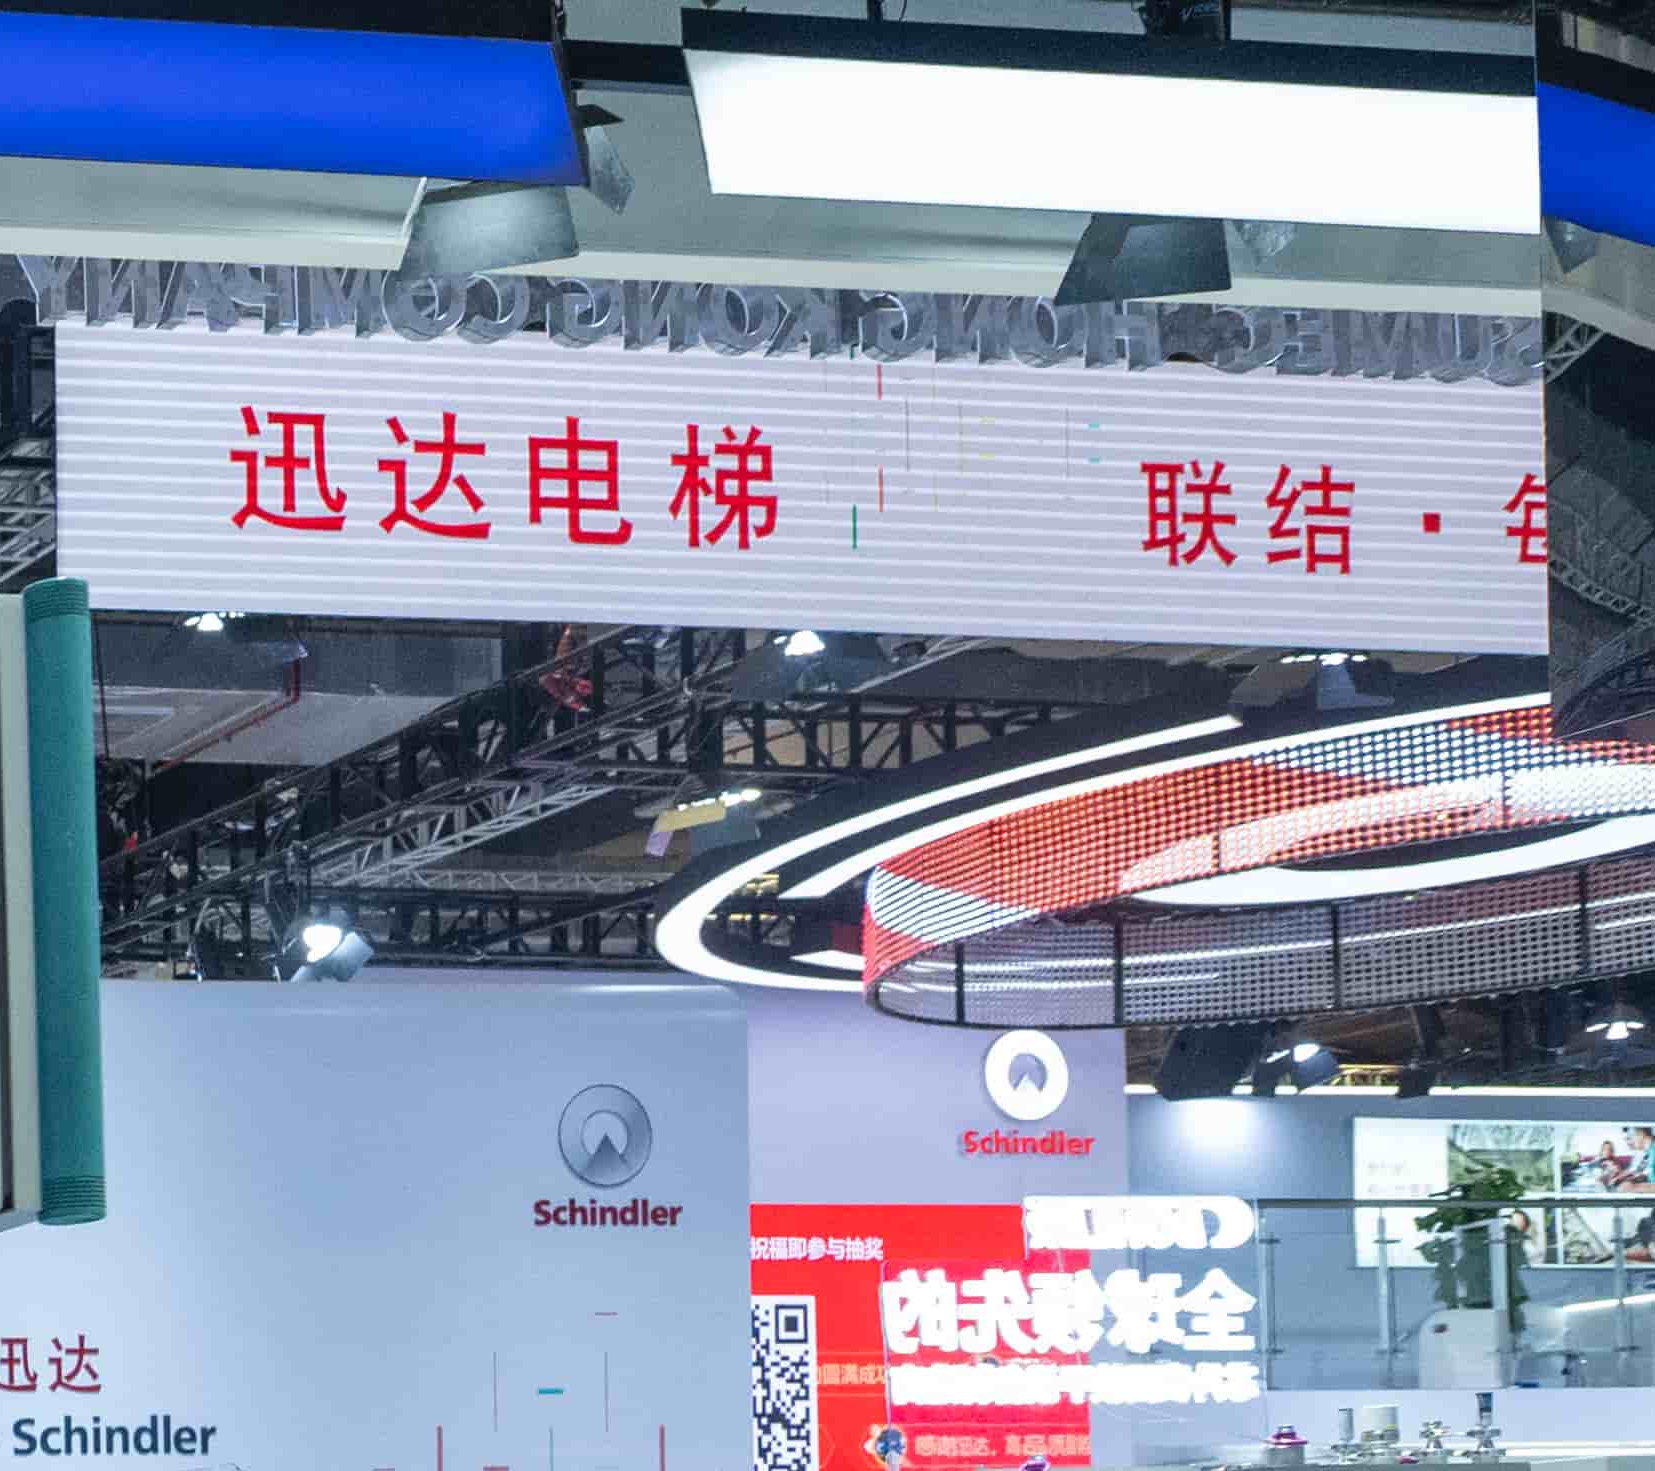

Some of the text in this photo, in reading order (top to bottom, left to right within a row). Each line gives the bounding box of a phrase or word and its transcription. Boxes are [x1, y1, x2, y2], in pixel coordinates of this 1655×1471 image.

[225, 404, 781, 554] 迅达电梯
[963, 1129, 1096, 1157] Schindler
[532, 1198, 682, 1228] Schindler
[11, 1413, 217, 1457] Schindler
